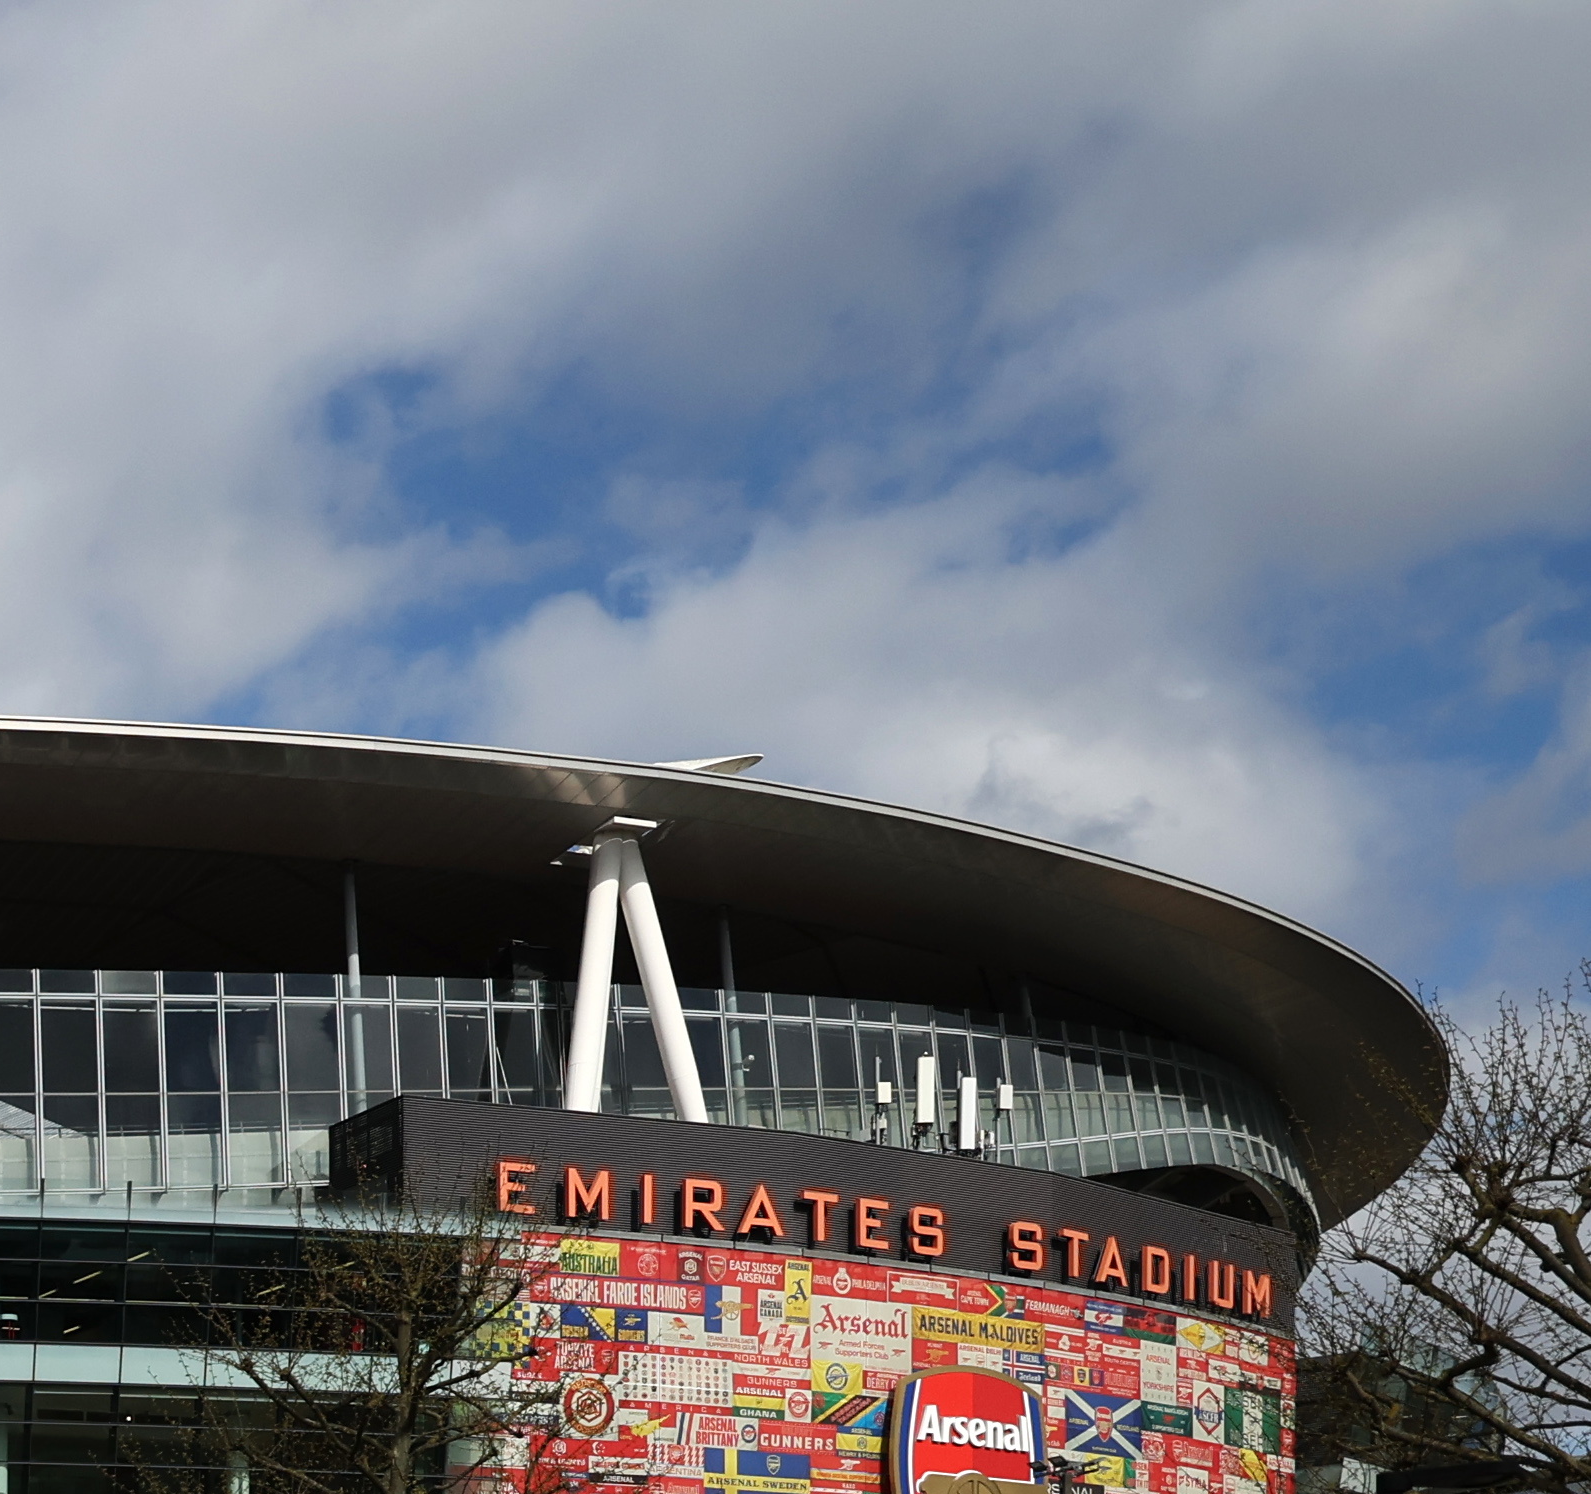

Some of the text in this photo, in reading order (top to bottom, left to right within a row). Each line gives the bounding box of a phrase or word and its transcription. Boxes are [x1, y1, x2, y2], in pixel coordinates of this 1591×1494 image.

[495, 1160, 1274, 1319] EMIRATES STADIUM
[559, 1251, 619, 1276] AUSTRALIA
[728, 1259, 784, 1275] EAST SUSSEX
[735, 1271, 777, 1286] ARSENAL
[603, 1281, 638, 1305] FAROE
[640, 1284, 687, 1310] ISLANDS
[1025, 1299, 1071, 1316] FERMANAGH
[813, 1302, 910, 1340] Arsenal
[919, 1314, 1040, 1346] ARSENAL MALDIVES
[838, 1339, 887, 1350] Armed Forces
[734, 1353, 809, 1368] NORTH WALES
[834, 1347, 890, 1361] Supporters Club
[1145, 1355, 1172, 1366] ARSENAL
[746, 1376, 798, 1388] GUNNERS
[735, 1386, 784, 1397] ARSENAL
[739, 1408, 778, 1419] GHANA
[698, 1416, 738, 1433] ARSENAL
[916, 1404, 1031, 1453] Arsenal
[695, 1430, 740, 1448] BRITTANY
[760, 1433, 835, 1451] GUNNERS
[602, 1475, 635, 1484] ARSENAL
[706, 1477, 808, 1491] ARSENAL SWEDEN
